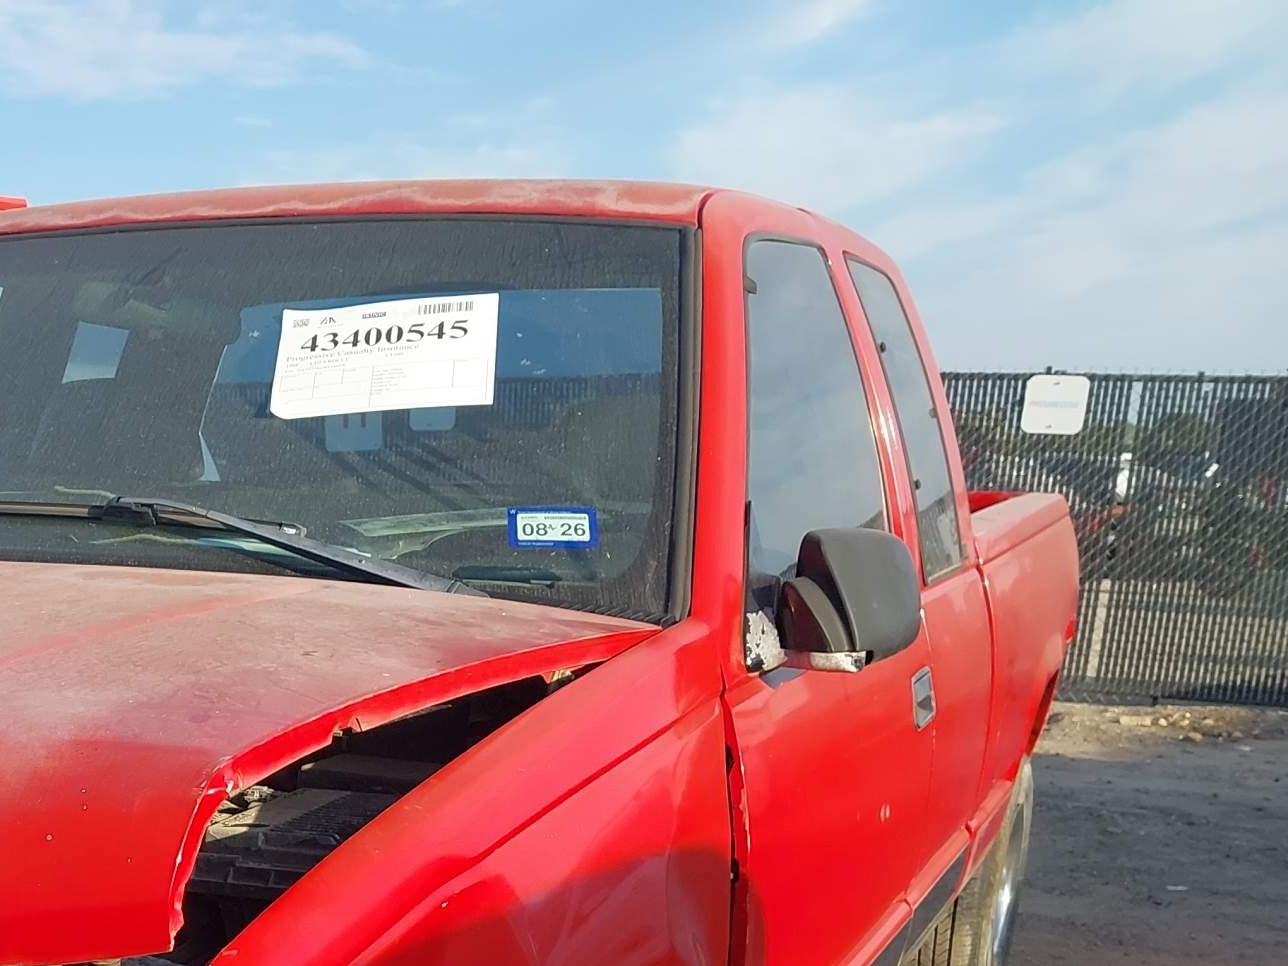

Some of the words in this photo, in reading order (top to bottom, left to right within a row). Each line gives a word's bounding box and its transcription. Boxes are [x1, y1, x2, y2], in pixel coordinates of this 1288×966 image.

[300, 319, 469, 352] 43400545
[522, 523, 548, 536] 08
[560, 523, 586, 536] 26
